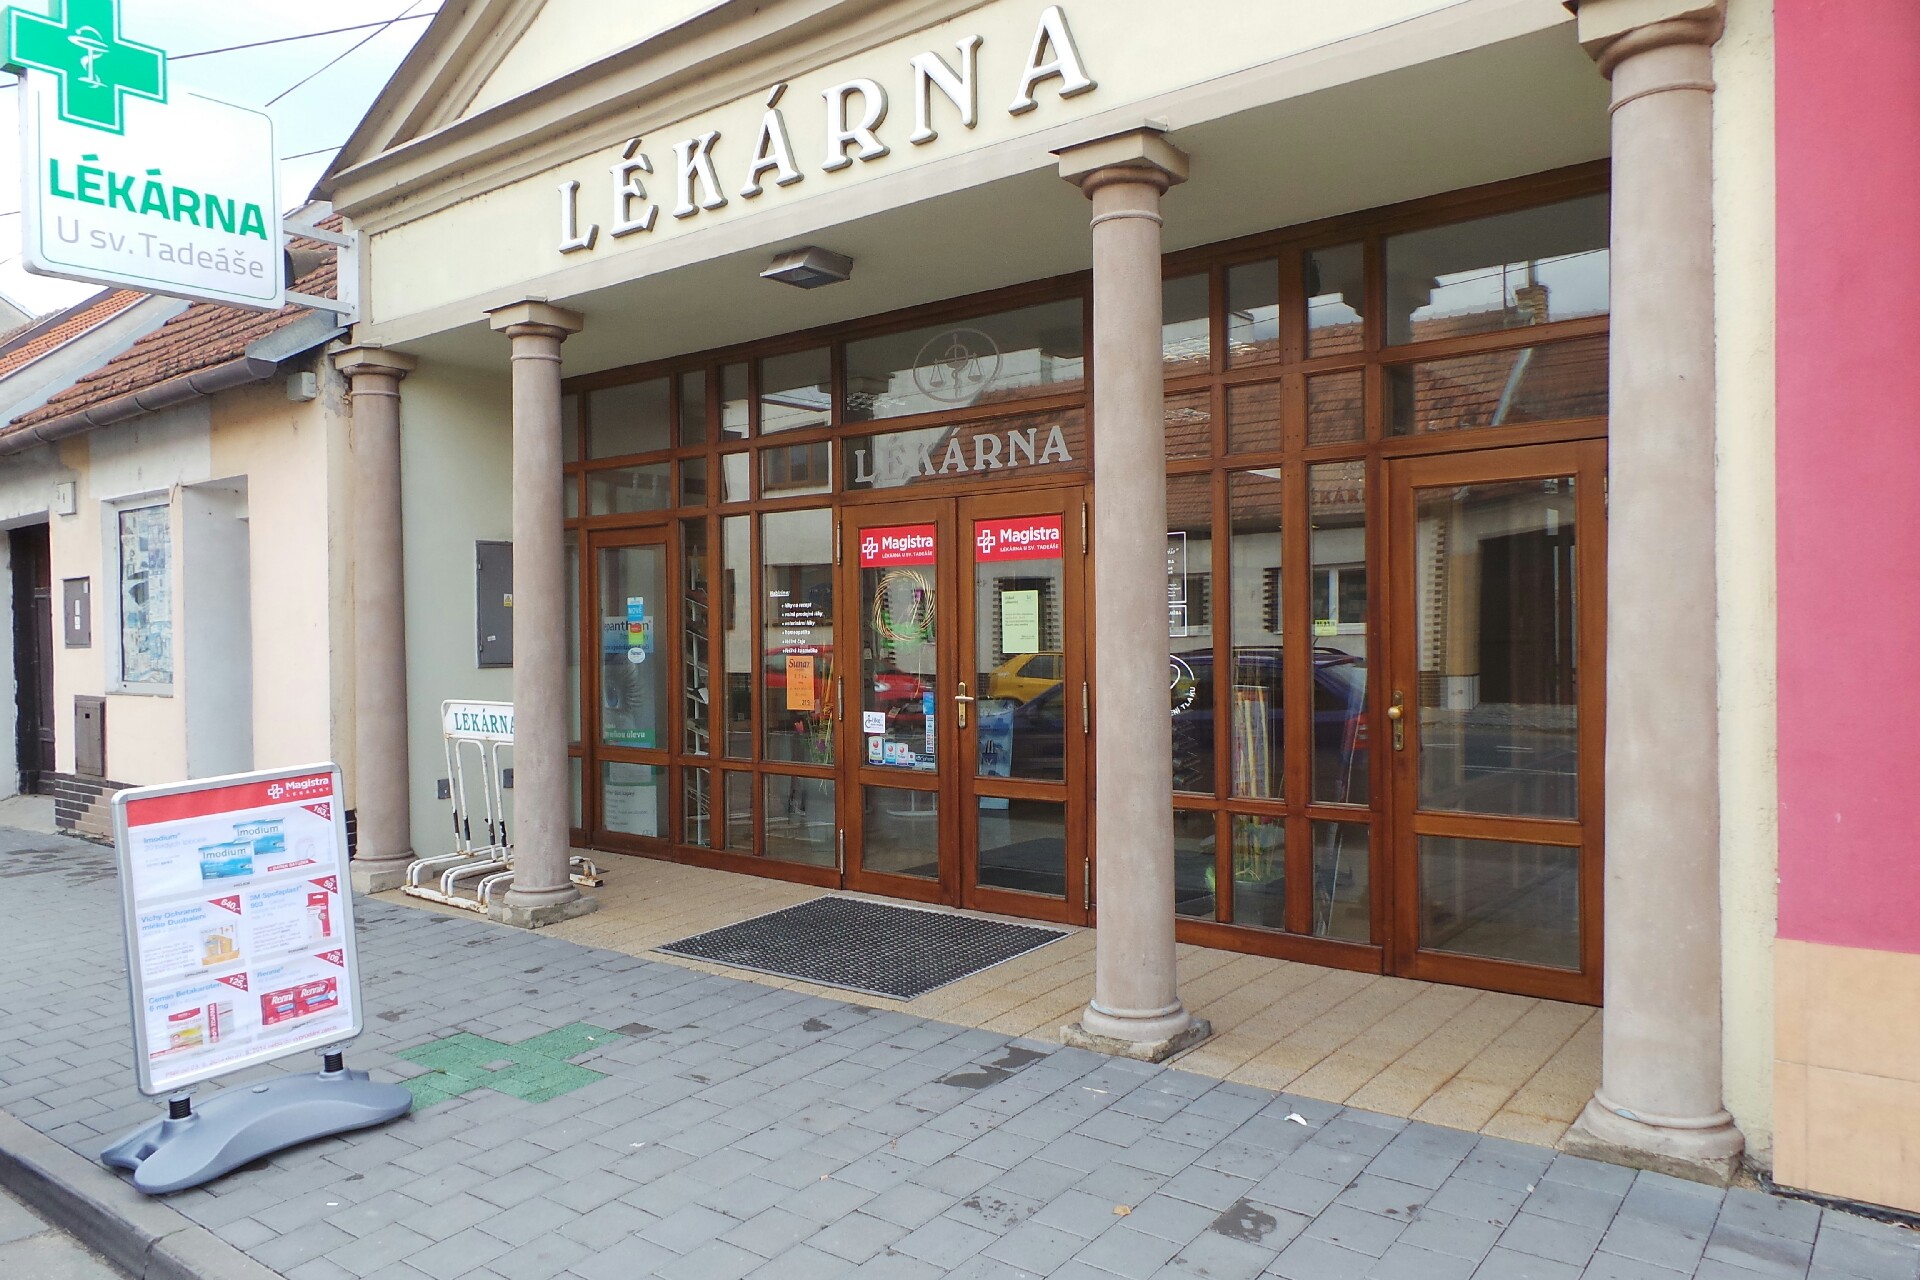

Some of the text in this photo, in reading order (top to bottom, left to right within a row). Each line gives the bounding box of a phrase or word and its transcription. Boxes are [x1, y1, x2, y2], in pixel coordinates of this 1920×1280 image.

[558, 5, 1098, 254] LÉKÁRNA
[50, 153, 268, 240] LÉKÁRNA
[57, 216, 264, 279] U sv. Tadeáše
[854, 425, 1073, 482] LÉKÁRNA
[882, 534, 934, 551] Magistra
[1000, 526, 1060, 544] Magistra
[285, 777, 329, 791] Magistra
[237, 825, 279, 836] Imodium
[202, 847, 246, 859] Imodium
[271, 990, 293, 1005] Renni
[301, 984, 326, 998] Rennie
